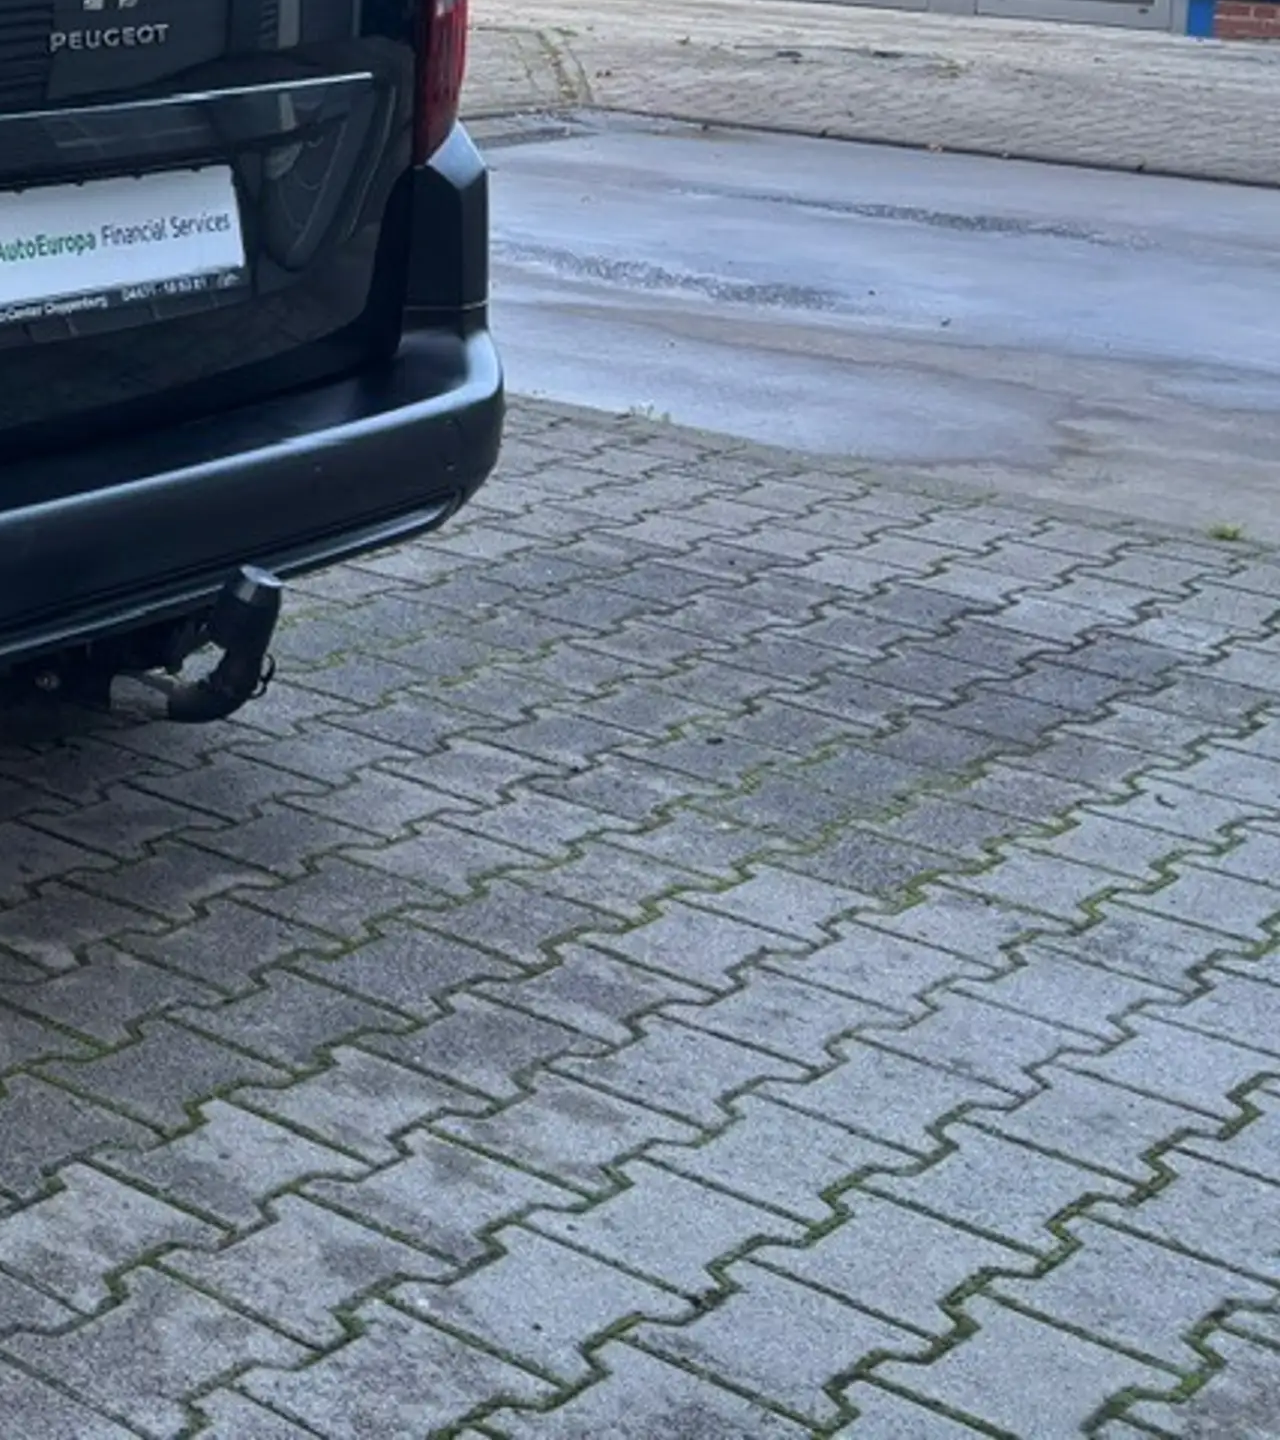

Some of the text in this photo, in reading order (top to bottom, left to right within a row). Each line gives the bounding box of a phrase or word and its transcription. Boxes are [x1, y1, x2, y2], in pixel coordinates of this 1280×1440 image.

[49, 23, 169, 53] PEUGEOT
[100, 217, 166, 247] Financial
[170, 212, 231, 239] Services
